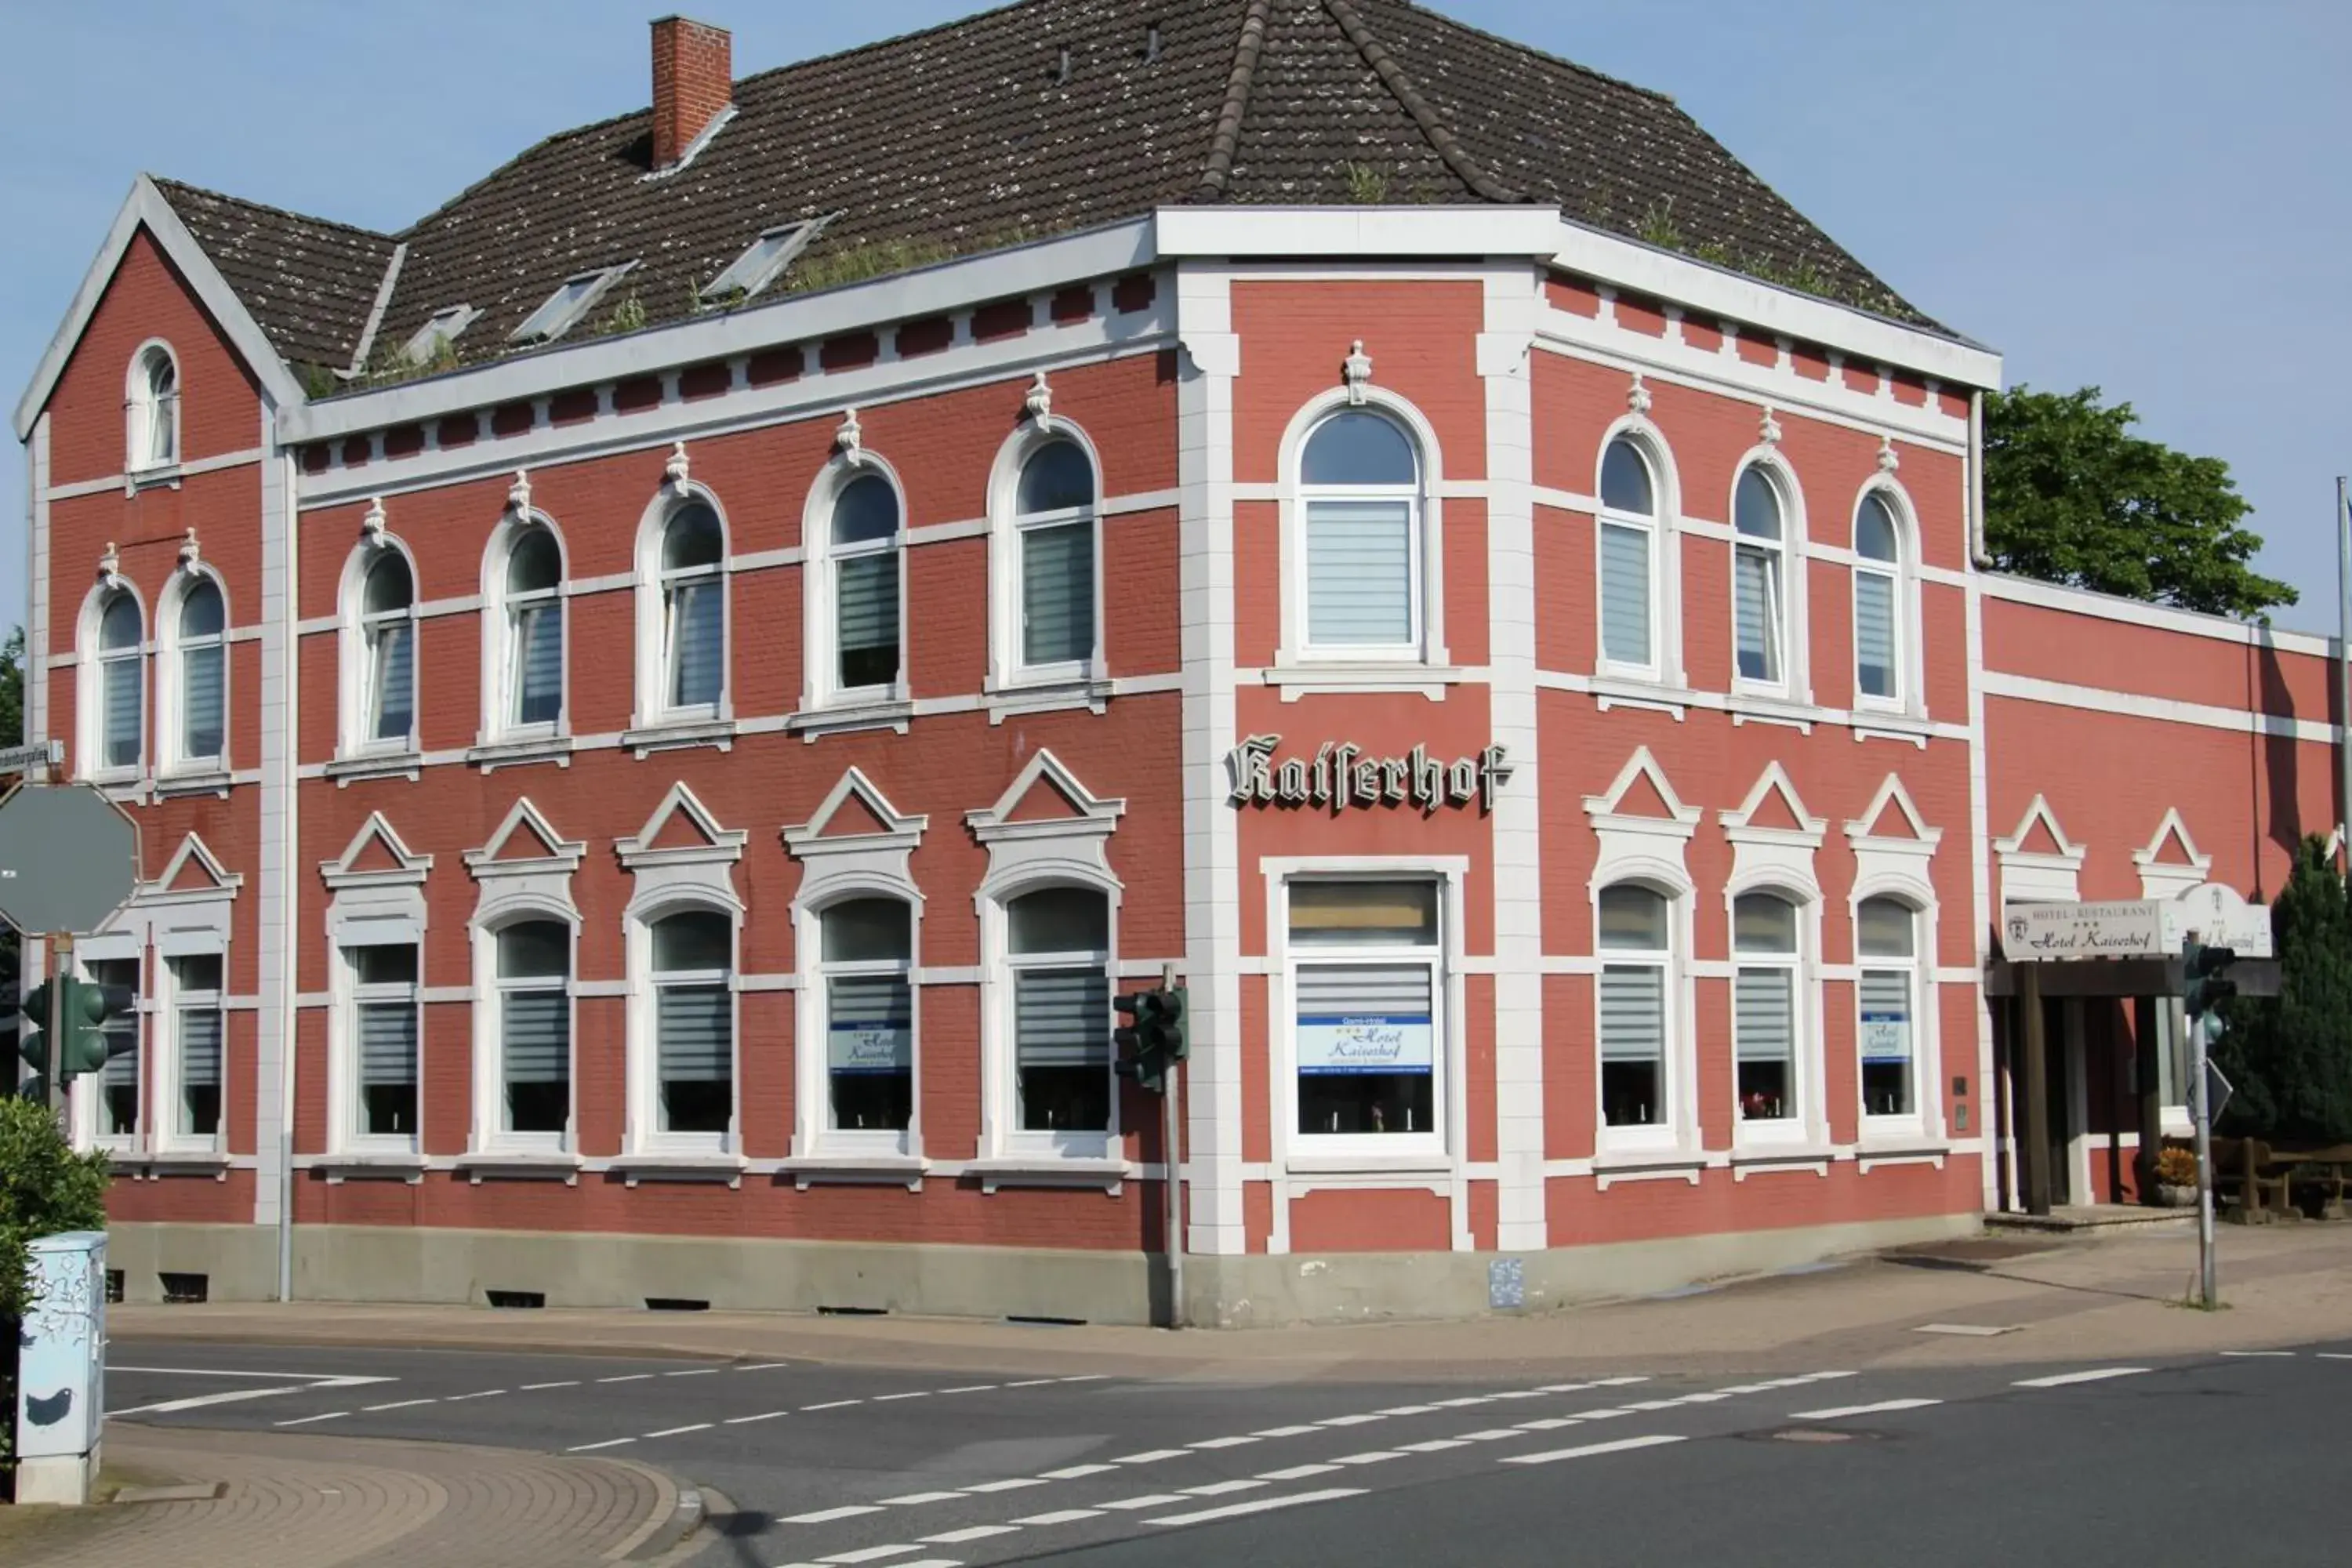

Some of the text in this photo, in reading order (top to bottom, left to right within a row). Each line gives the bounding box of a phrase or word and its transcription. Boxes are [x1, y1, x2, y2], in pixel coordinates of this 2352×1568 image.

[1226, 733, 1515, 814] Kaiserhof
[2030, 931, 2077, 949] Hotel
[2081, 930, 2151, 949] Kaiserhof
[1352, 1027, 1402, 1044] Hotel
[1327, 1040, 1401, 1060] Kaiserhof
